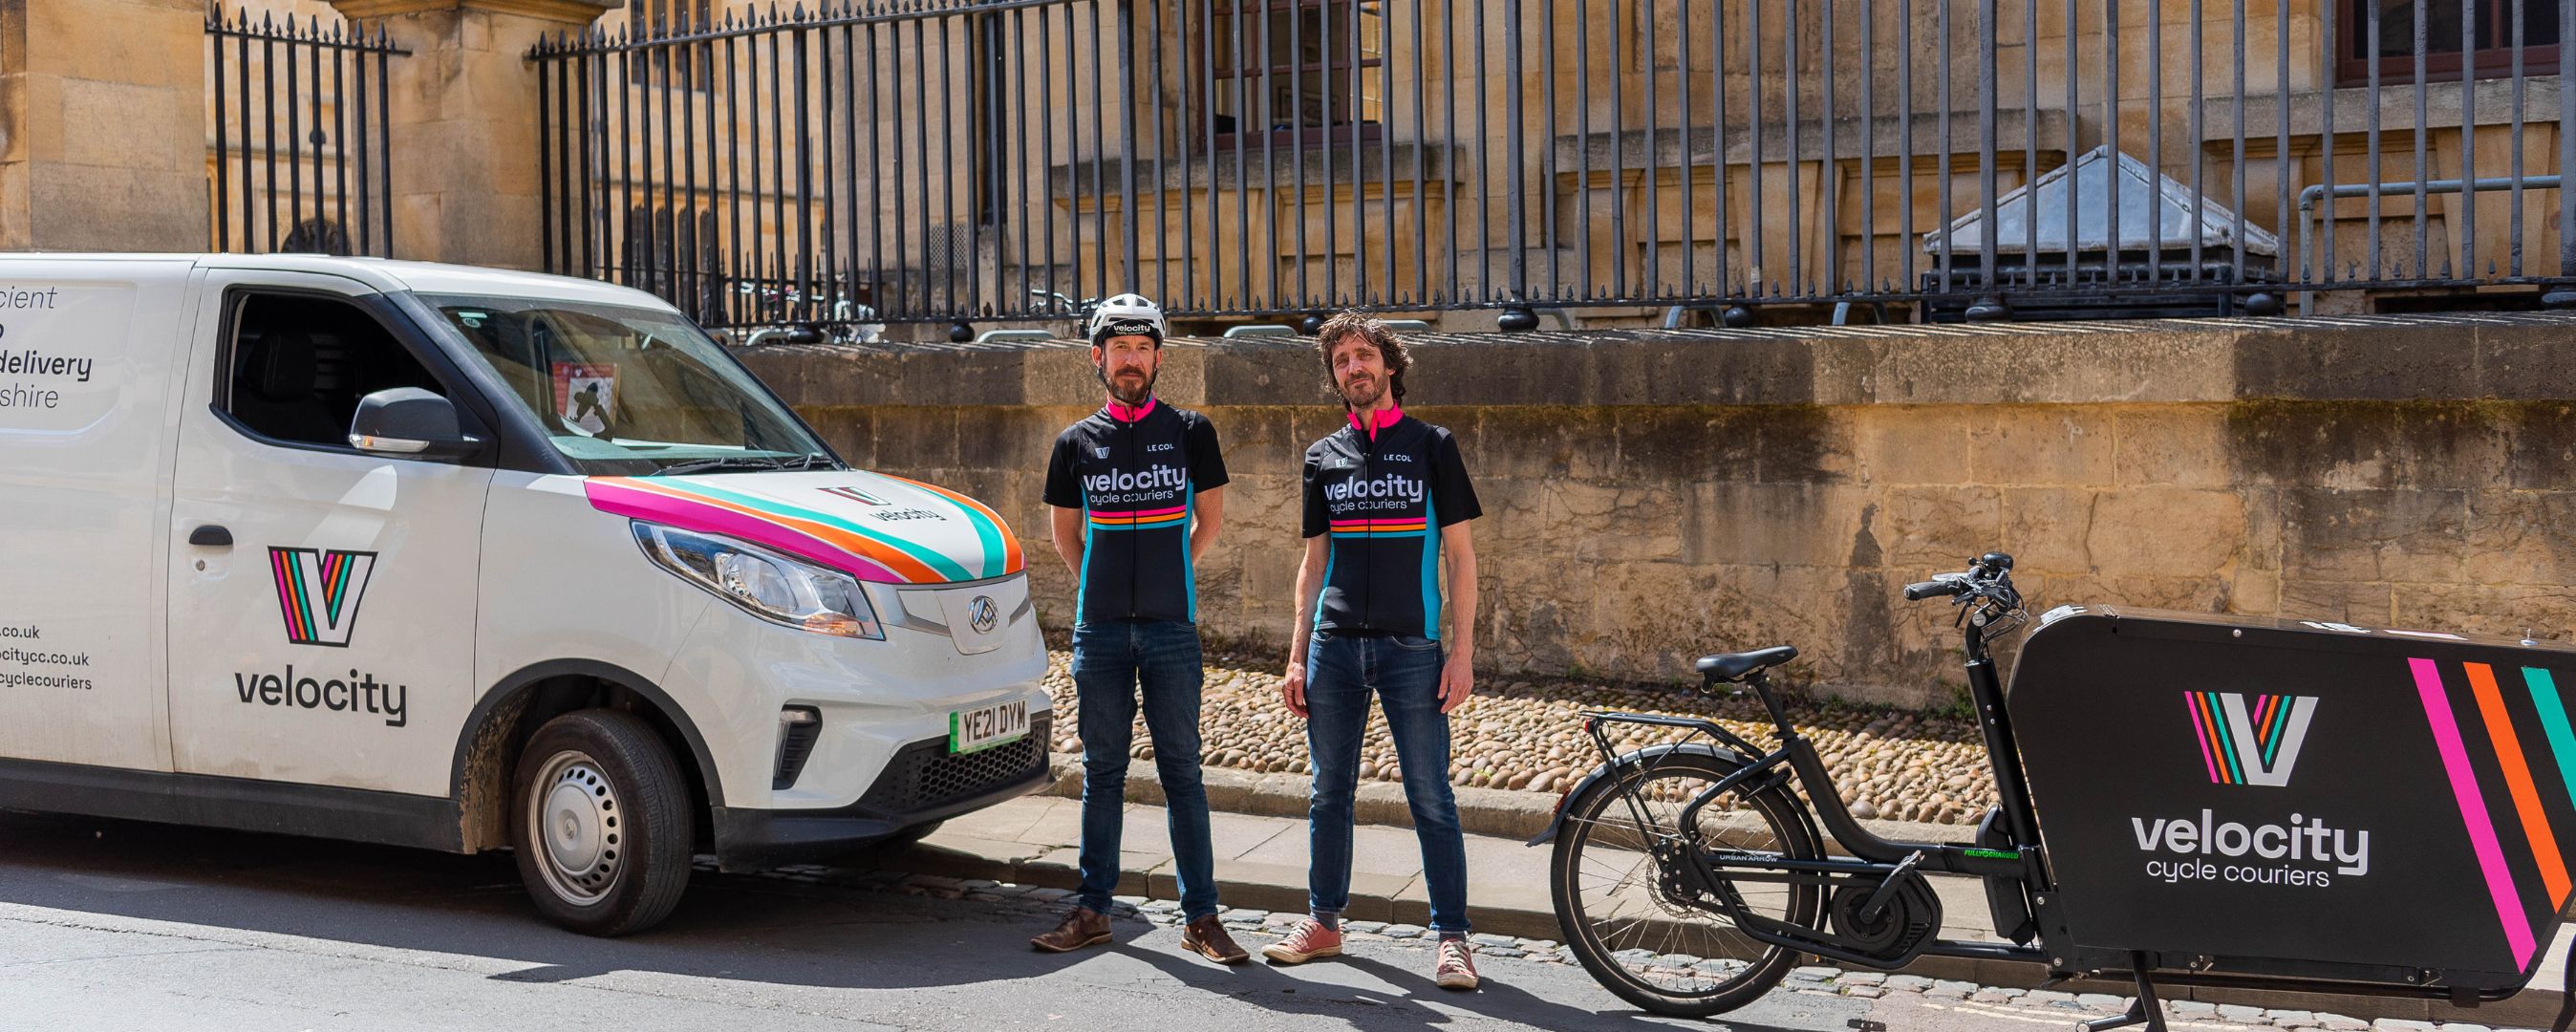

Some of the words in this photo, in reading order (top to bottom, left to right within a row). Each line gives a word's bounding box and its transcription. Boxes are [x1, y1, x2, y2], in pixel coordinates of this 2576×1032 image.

[0, 350, 93, 382] delivery
[0, 382, 58, 408] shire
[1084, 464, 1187, 491] velocity
[1324, 473, 1423, 503] velocity
[1089, 492, 1120, 505] cycle
[1330, 500, 1355, 514] cycle
[869, 507, 948, 522] velocity
[0, 647, 90, 666] citycc.co.uk
[0, 671, 93, 690] cyclecouriers
[234, 664, 407, 727] velocity
[964, 707, 996, 742] YE21
[999, 700, 1026, 735] DYM
[2131, 808, 2369, 876] velocity
[2146, 858, 2217, 883] cycle
[2223, 865, 2329, 888] couriers
